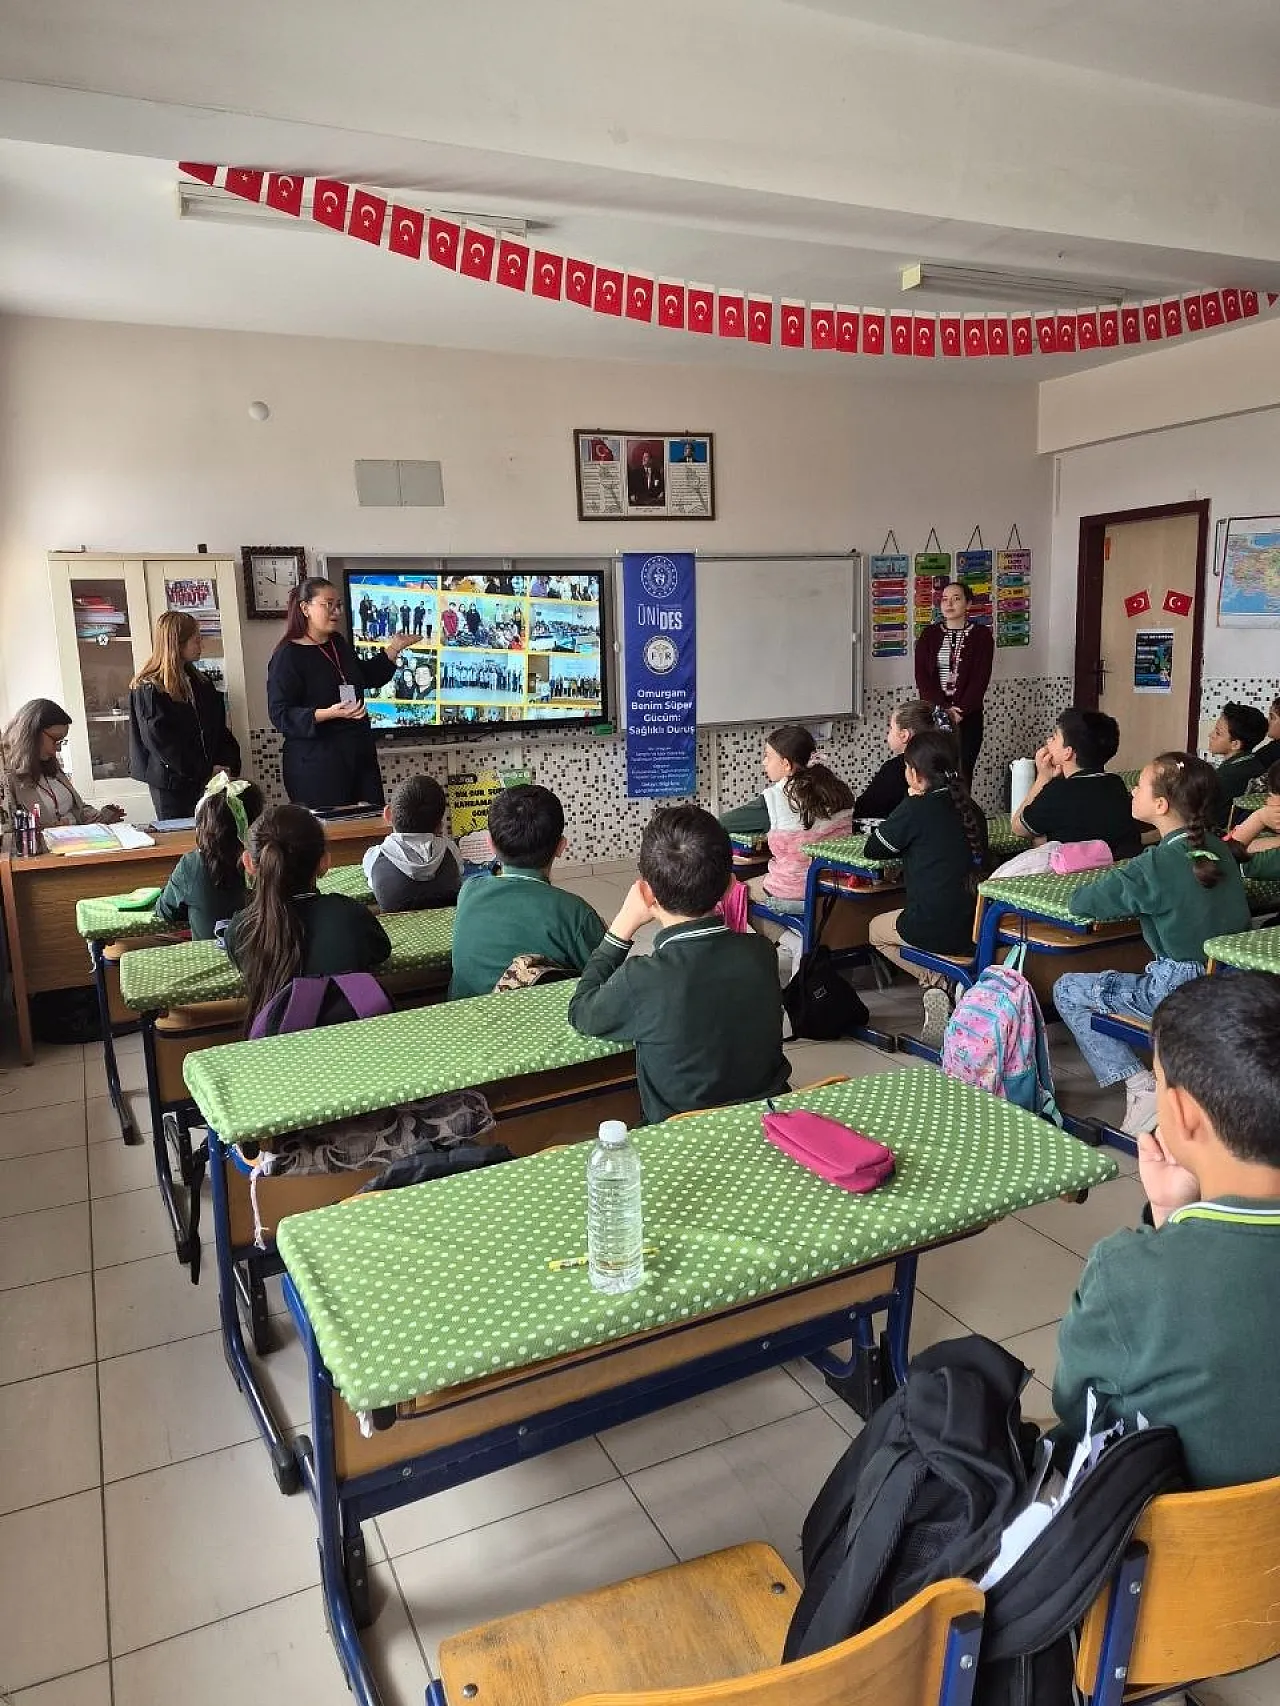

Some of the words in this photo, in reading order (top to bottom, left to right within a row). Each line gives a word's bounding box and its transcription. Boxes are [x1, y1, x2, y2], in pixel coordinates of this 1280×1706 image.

[637, 689, 686, 699] Omurgam
[631, 700, 663, 710] Benim
[664, 700, 693, 711] Süper
